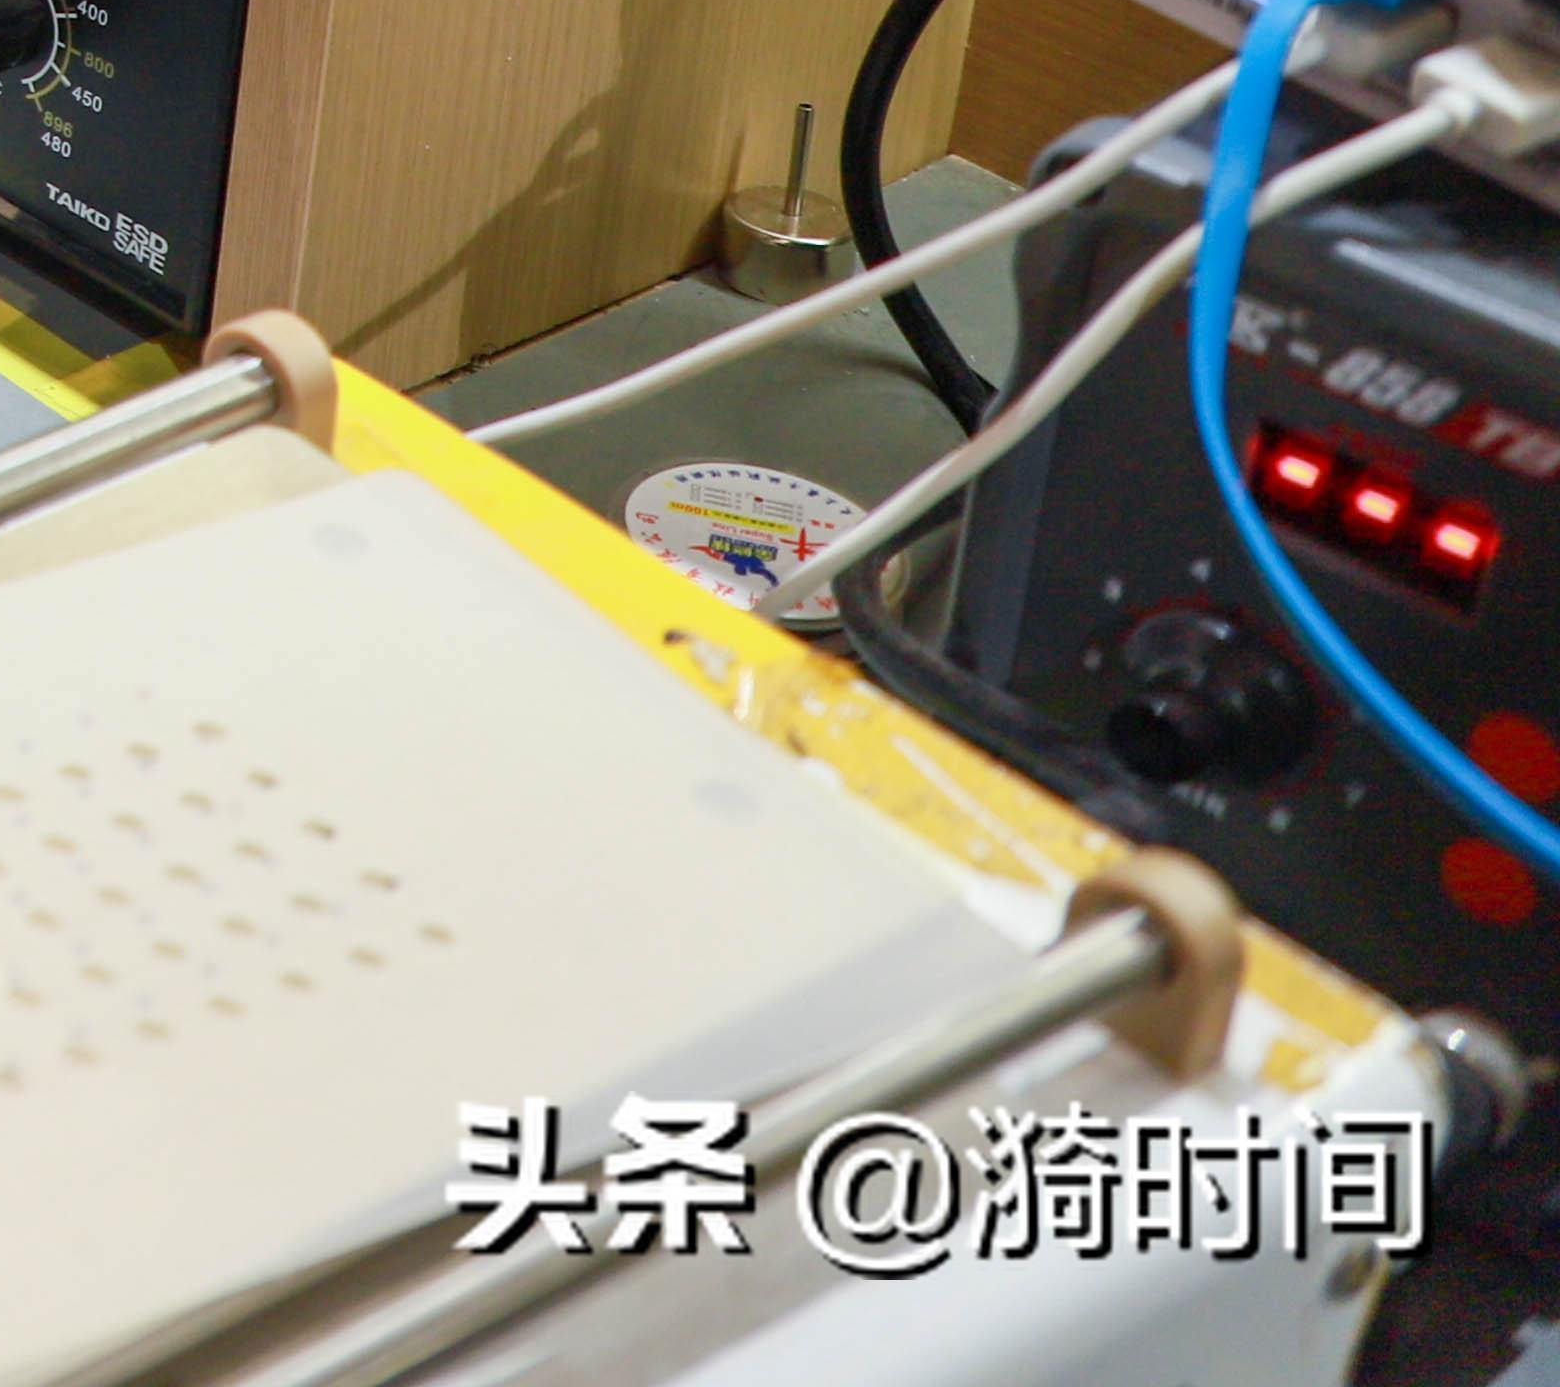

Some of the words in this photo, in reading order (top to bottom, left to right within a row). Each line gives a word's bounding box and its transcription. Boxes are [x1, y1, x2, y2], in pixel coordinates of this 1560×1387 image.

[76, 0, 109, 26] 400
[83, 51, 115, 79] 800
[72, 86, 103, 114] 450
[42, 111, 73, 139] 896
[40, 132, 72, 159] 480
[116, 212, 168, 255] ESD
[112, 230, 166, 275] SAFE
